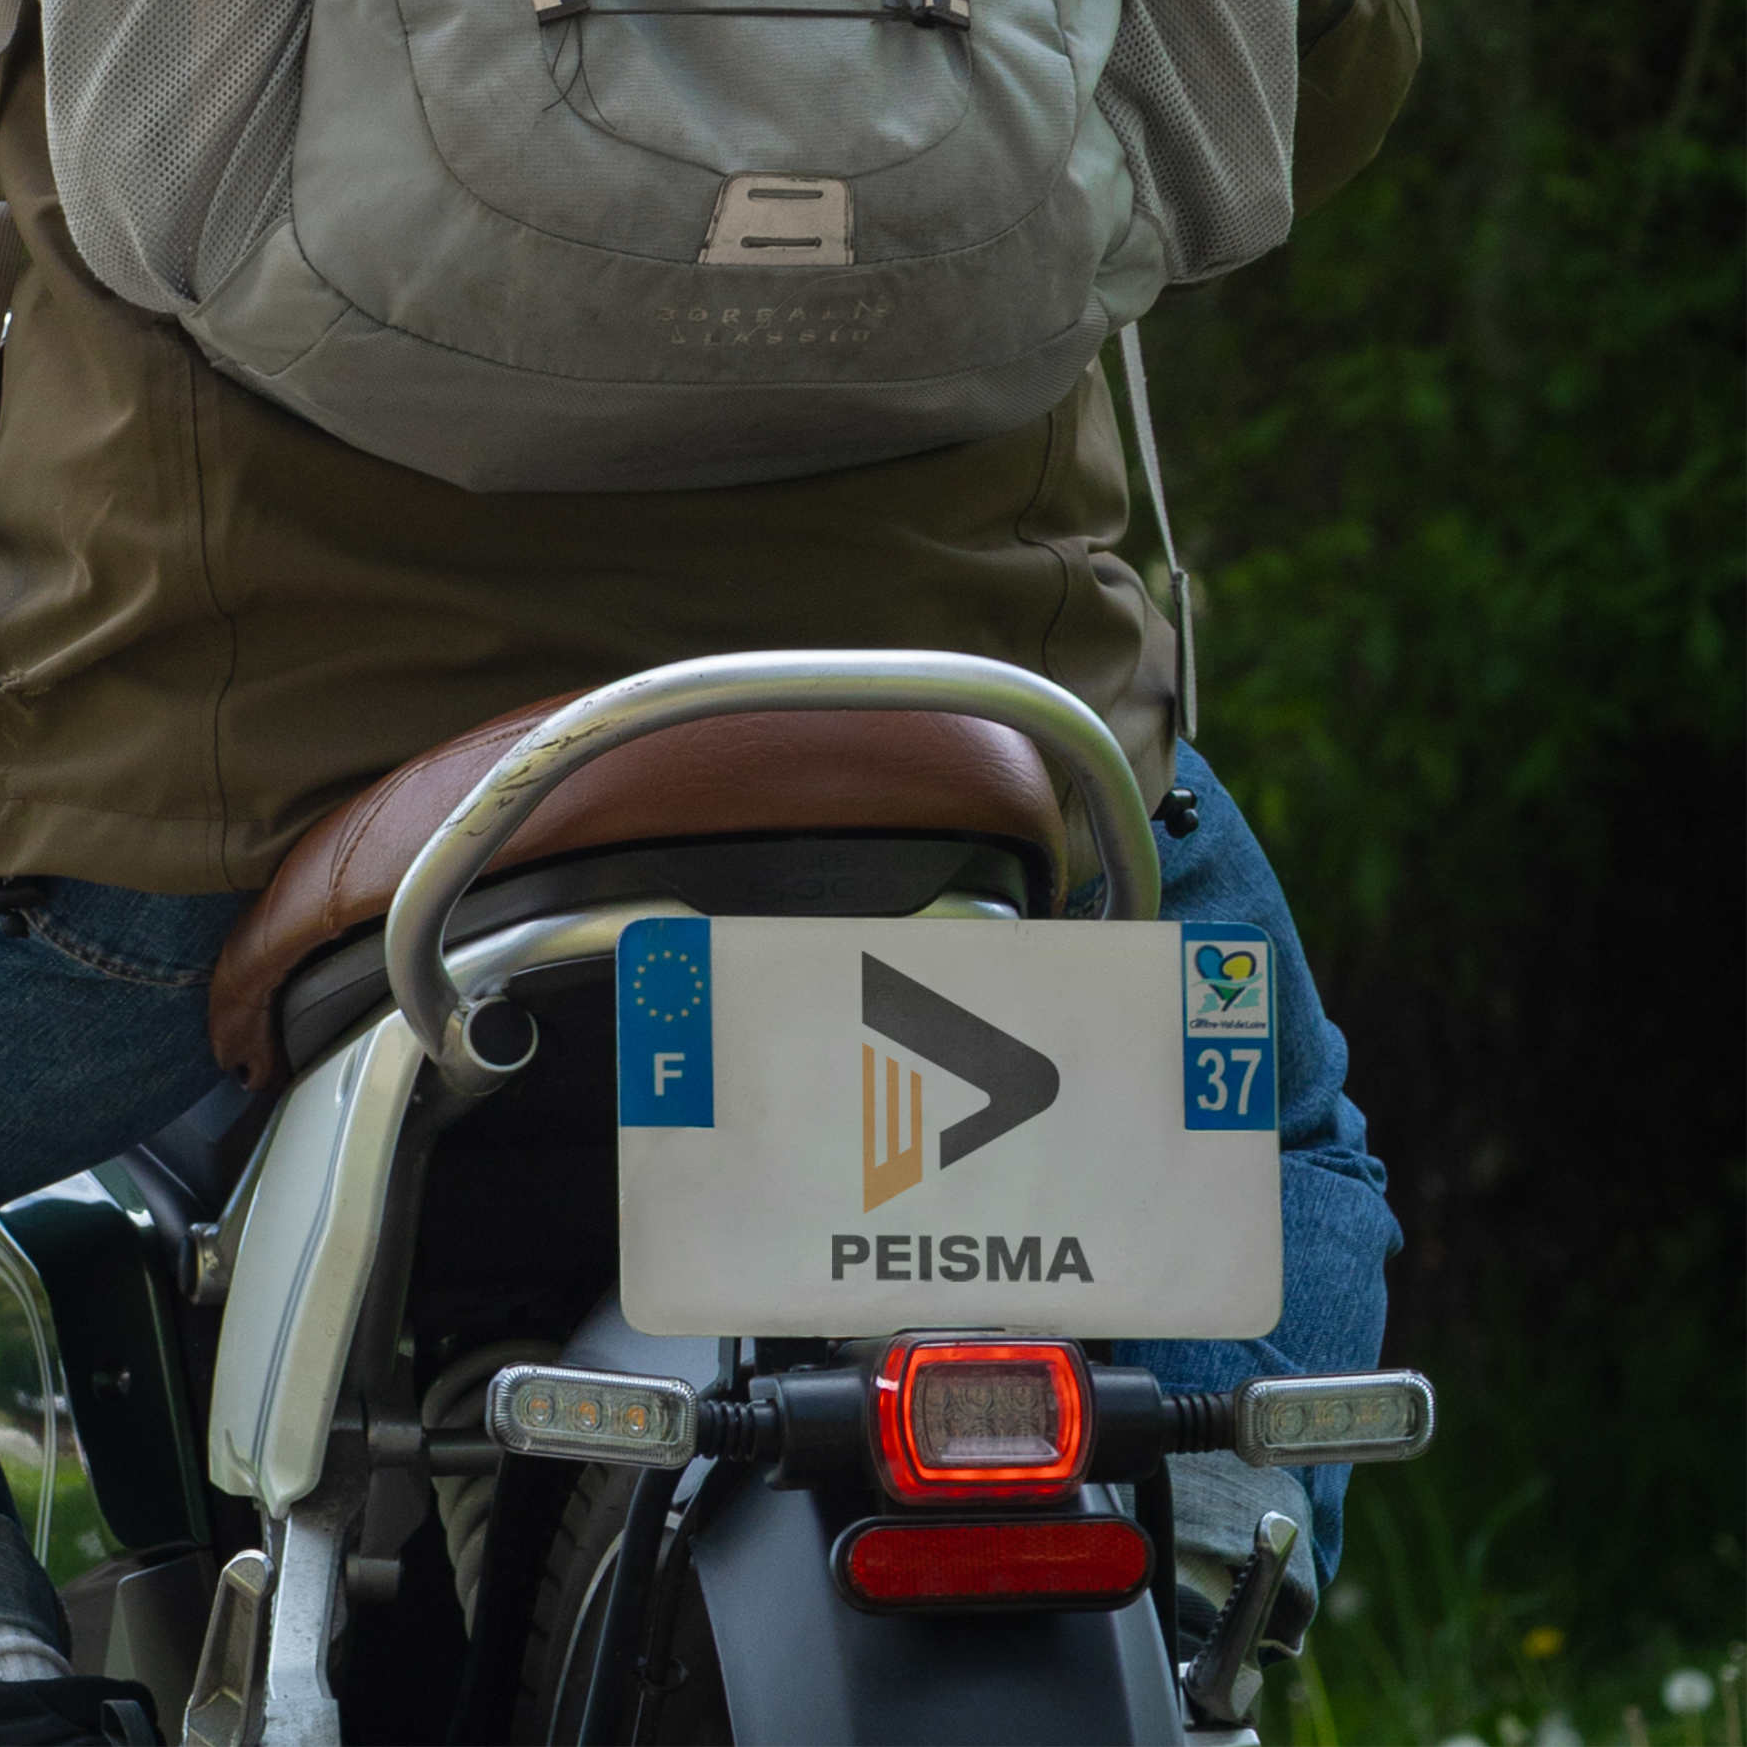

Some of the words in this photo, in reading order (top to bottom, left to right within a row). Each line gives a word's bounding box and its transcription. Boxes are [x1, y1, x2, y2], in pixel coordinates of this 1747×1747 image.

[654, 1052, 685, 1096] F
[1197, 1048, 1262, 1115] 37
[831, 1234, 1095, 1283] PEISMA
